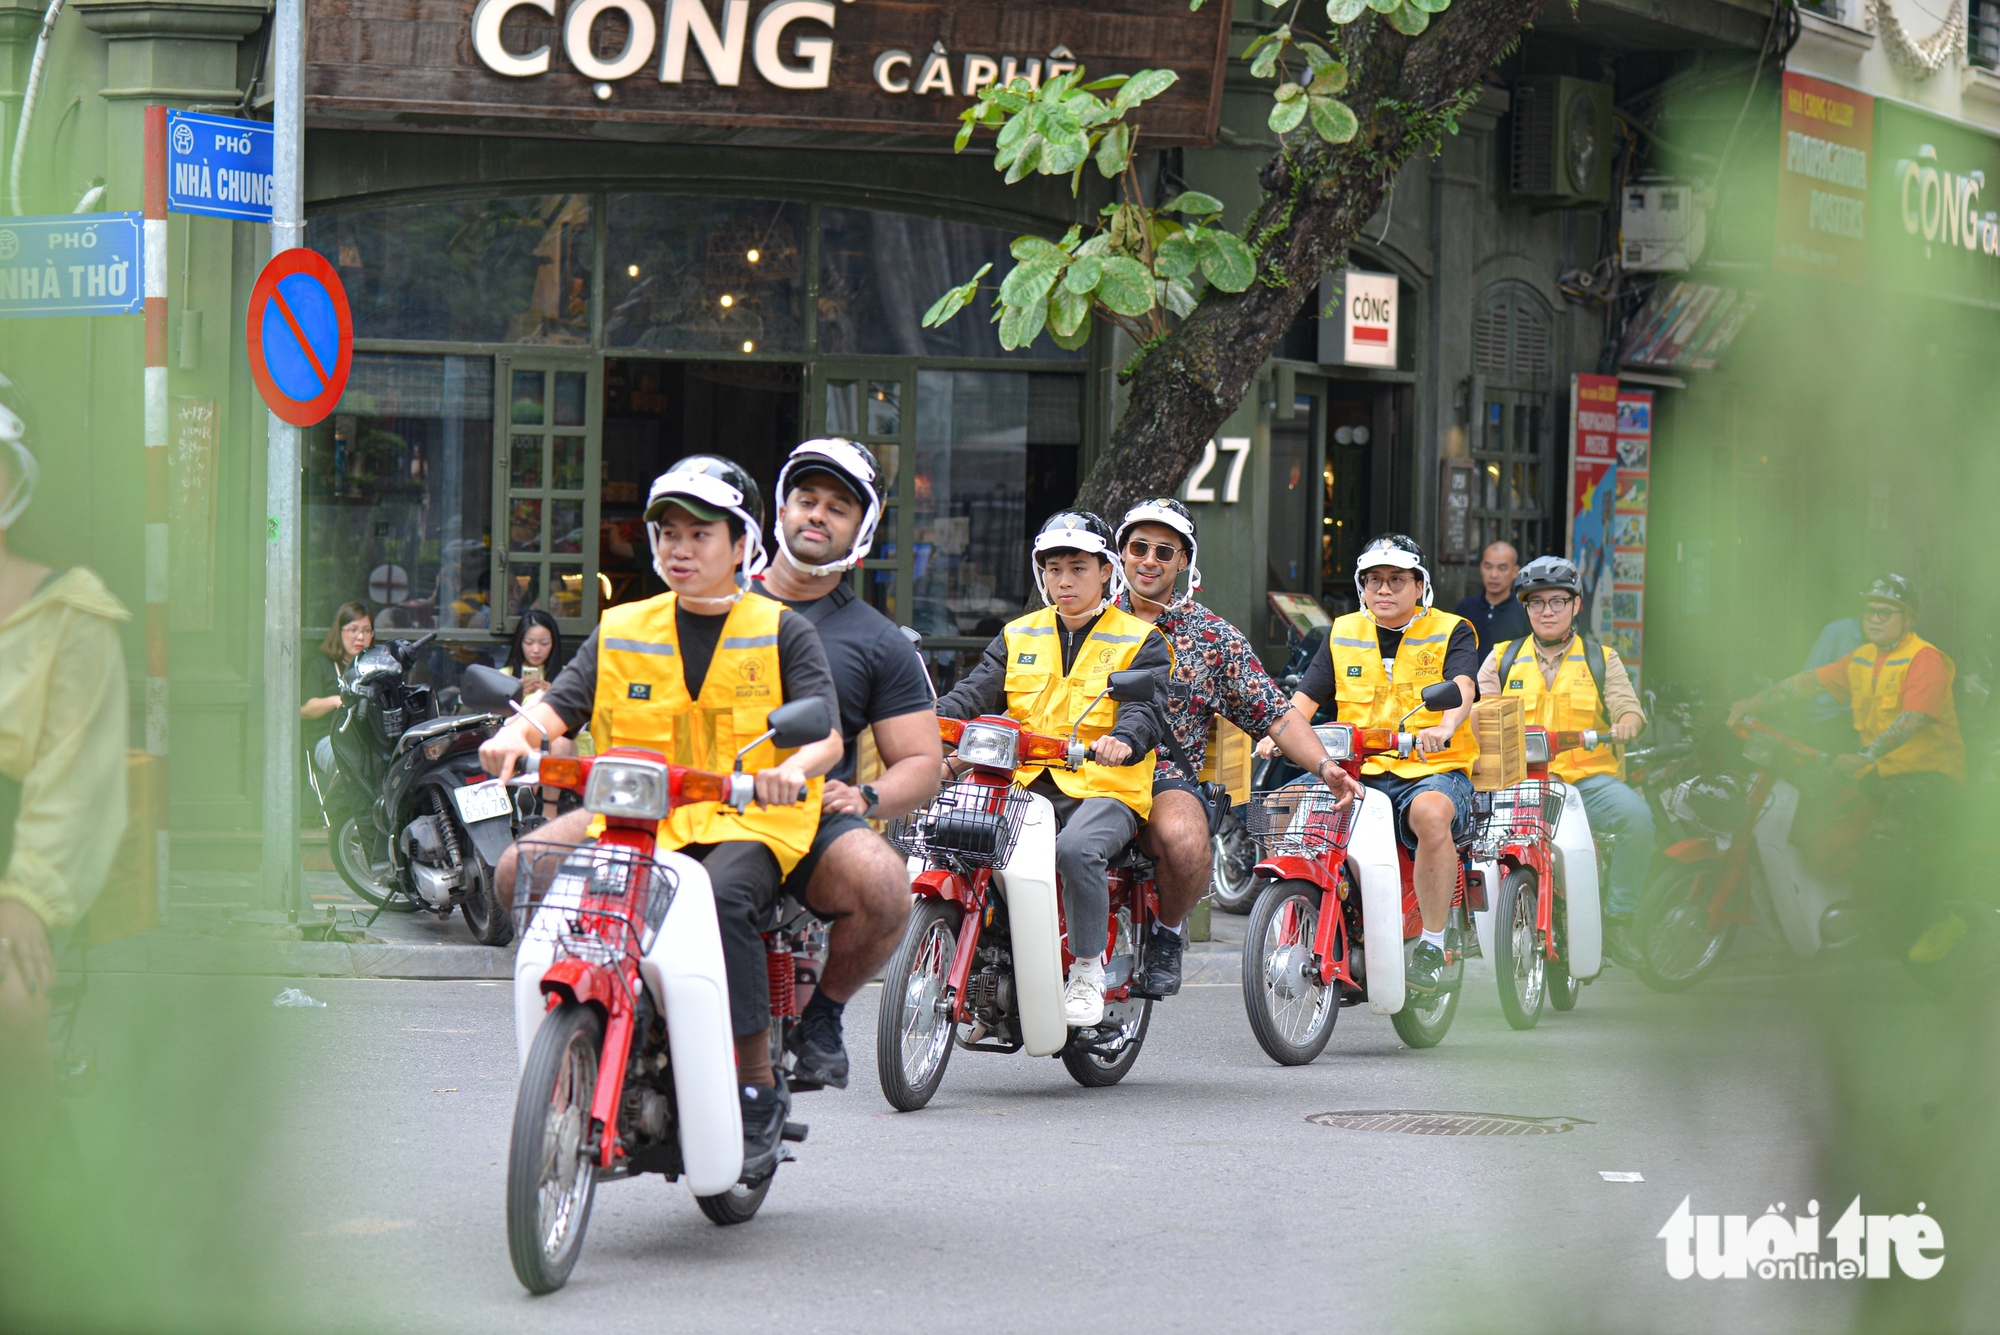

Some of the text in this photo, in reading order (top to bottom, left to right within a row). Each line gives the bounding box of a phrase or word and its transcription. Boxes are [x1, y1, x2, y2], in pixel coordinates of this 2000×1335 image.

[215, 131, 254, 155] PHỐ
[1786, 131, 1867, 190] PROPAGANDA
[175, 158, 274, 208] NHÀ CHUNG
[49, 223, 99, 249] PHỐ
[0, 255, 129, 300] NHÀ THỜ
[1182, 437, 1251, 503] 27
